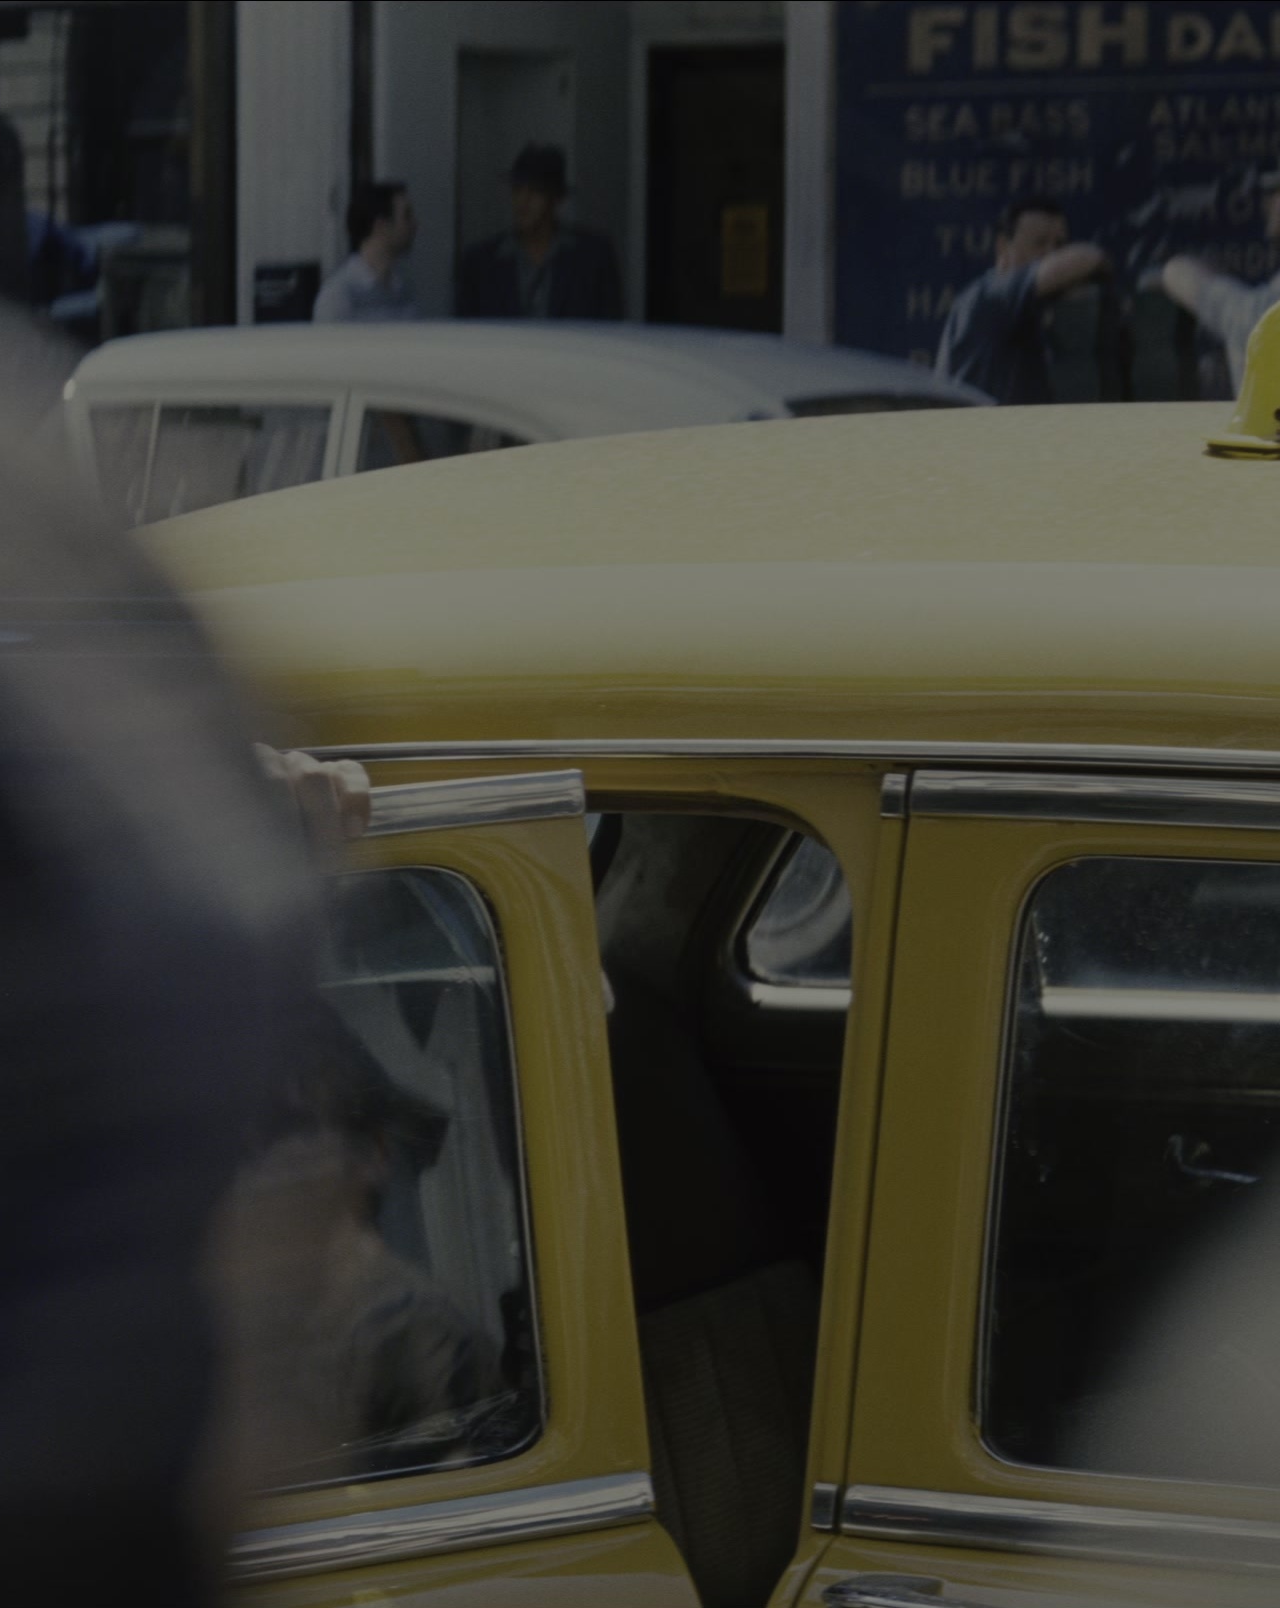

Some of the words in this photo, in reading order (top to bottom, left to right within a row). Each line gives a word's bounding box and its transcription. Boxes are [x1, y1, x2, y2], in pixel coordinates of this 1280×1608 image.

[906, 4, 1150, 75] FISH
[904, 103, 979, 142] SEA
[989, 98, 1091, 140] BASS
[900, 159, 1000, 200] BLUE
[1008, 155, 1095, 195] FISH
